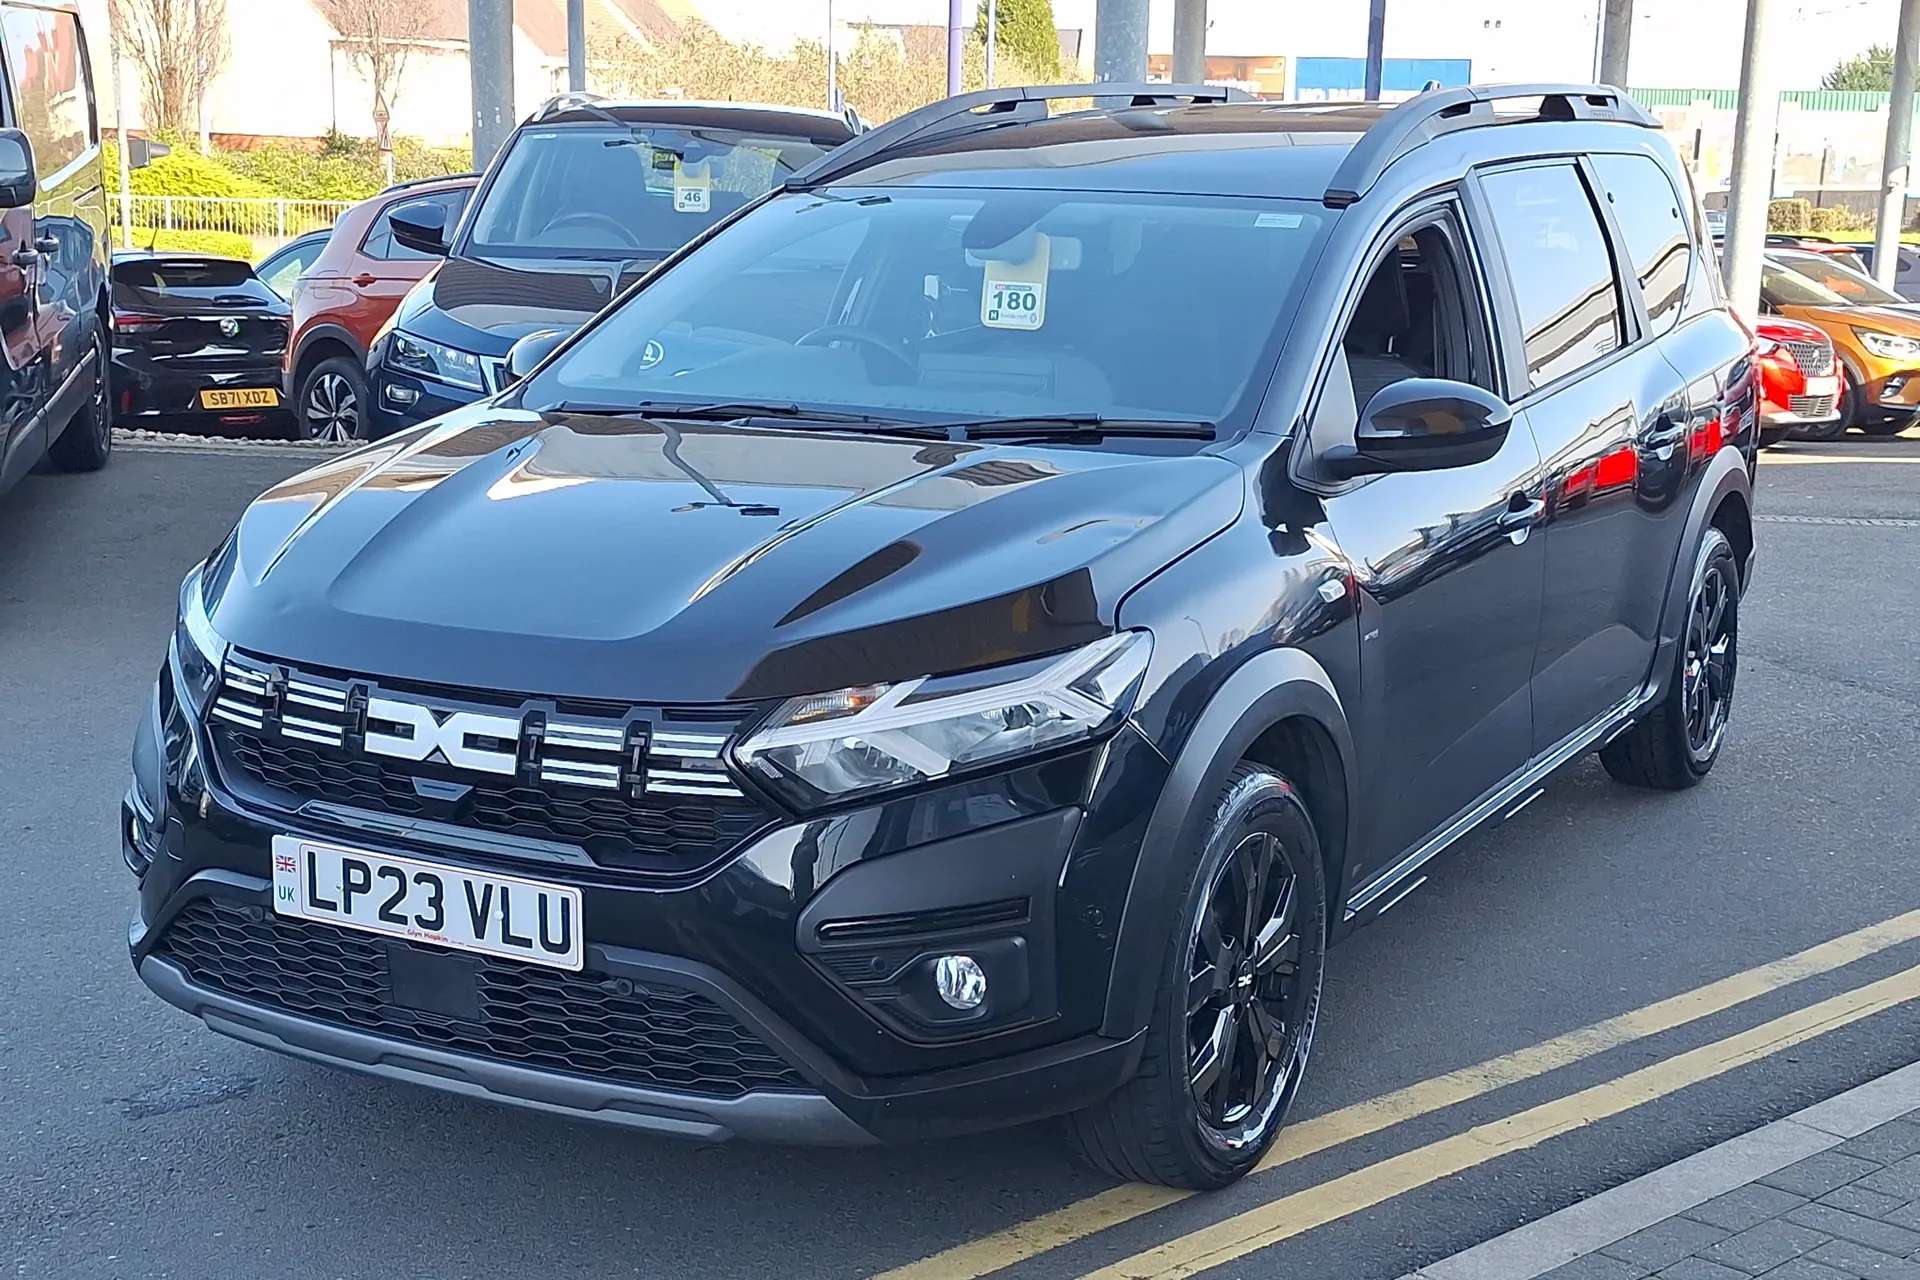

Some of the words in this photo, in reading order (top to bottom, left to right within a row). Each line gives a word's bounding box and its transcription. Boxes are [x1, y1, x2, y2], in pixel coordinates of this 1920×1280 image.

[684, 192, 701, 202] 46
[993, 291, 1037, 311] 180
[210, 391, 241, 405] SB71
[244, 391, 271, 404] XDZ
[278, 885, 295, 904] UK
[306, 851, 446, 932] LP23
[463, 879, 572, 955] VLU
